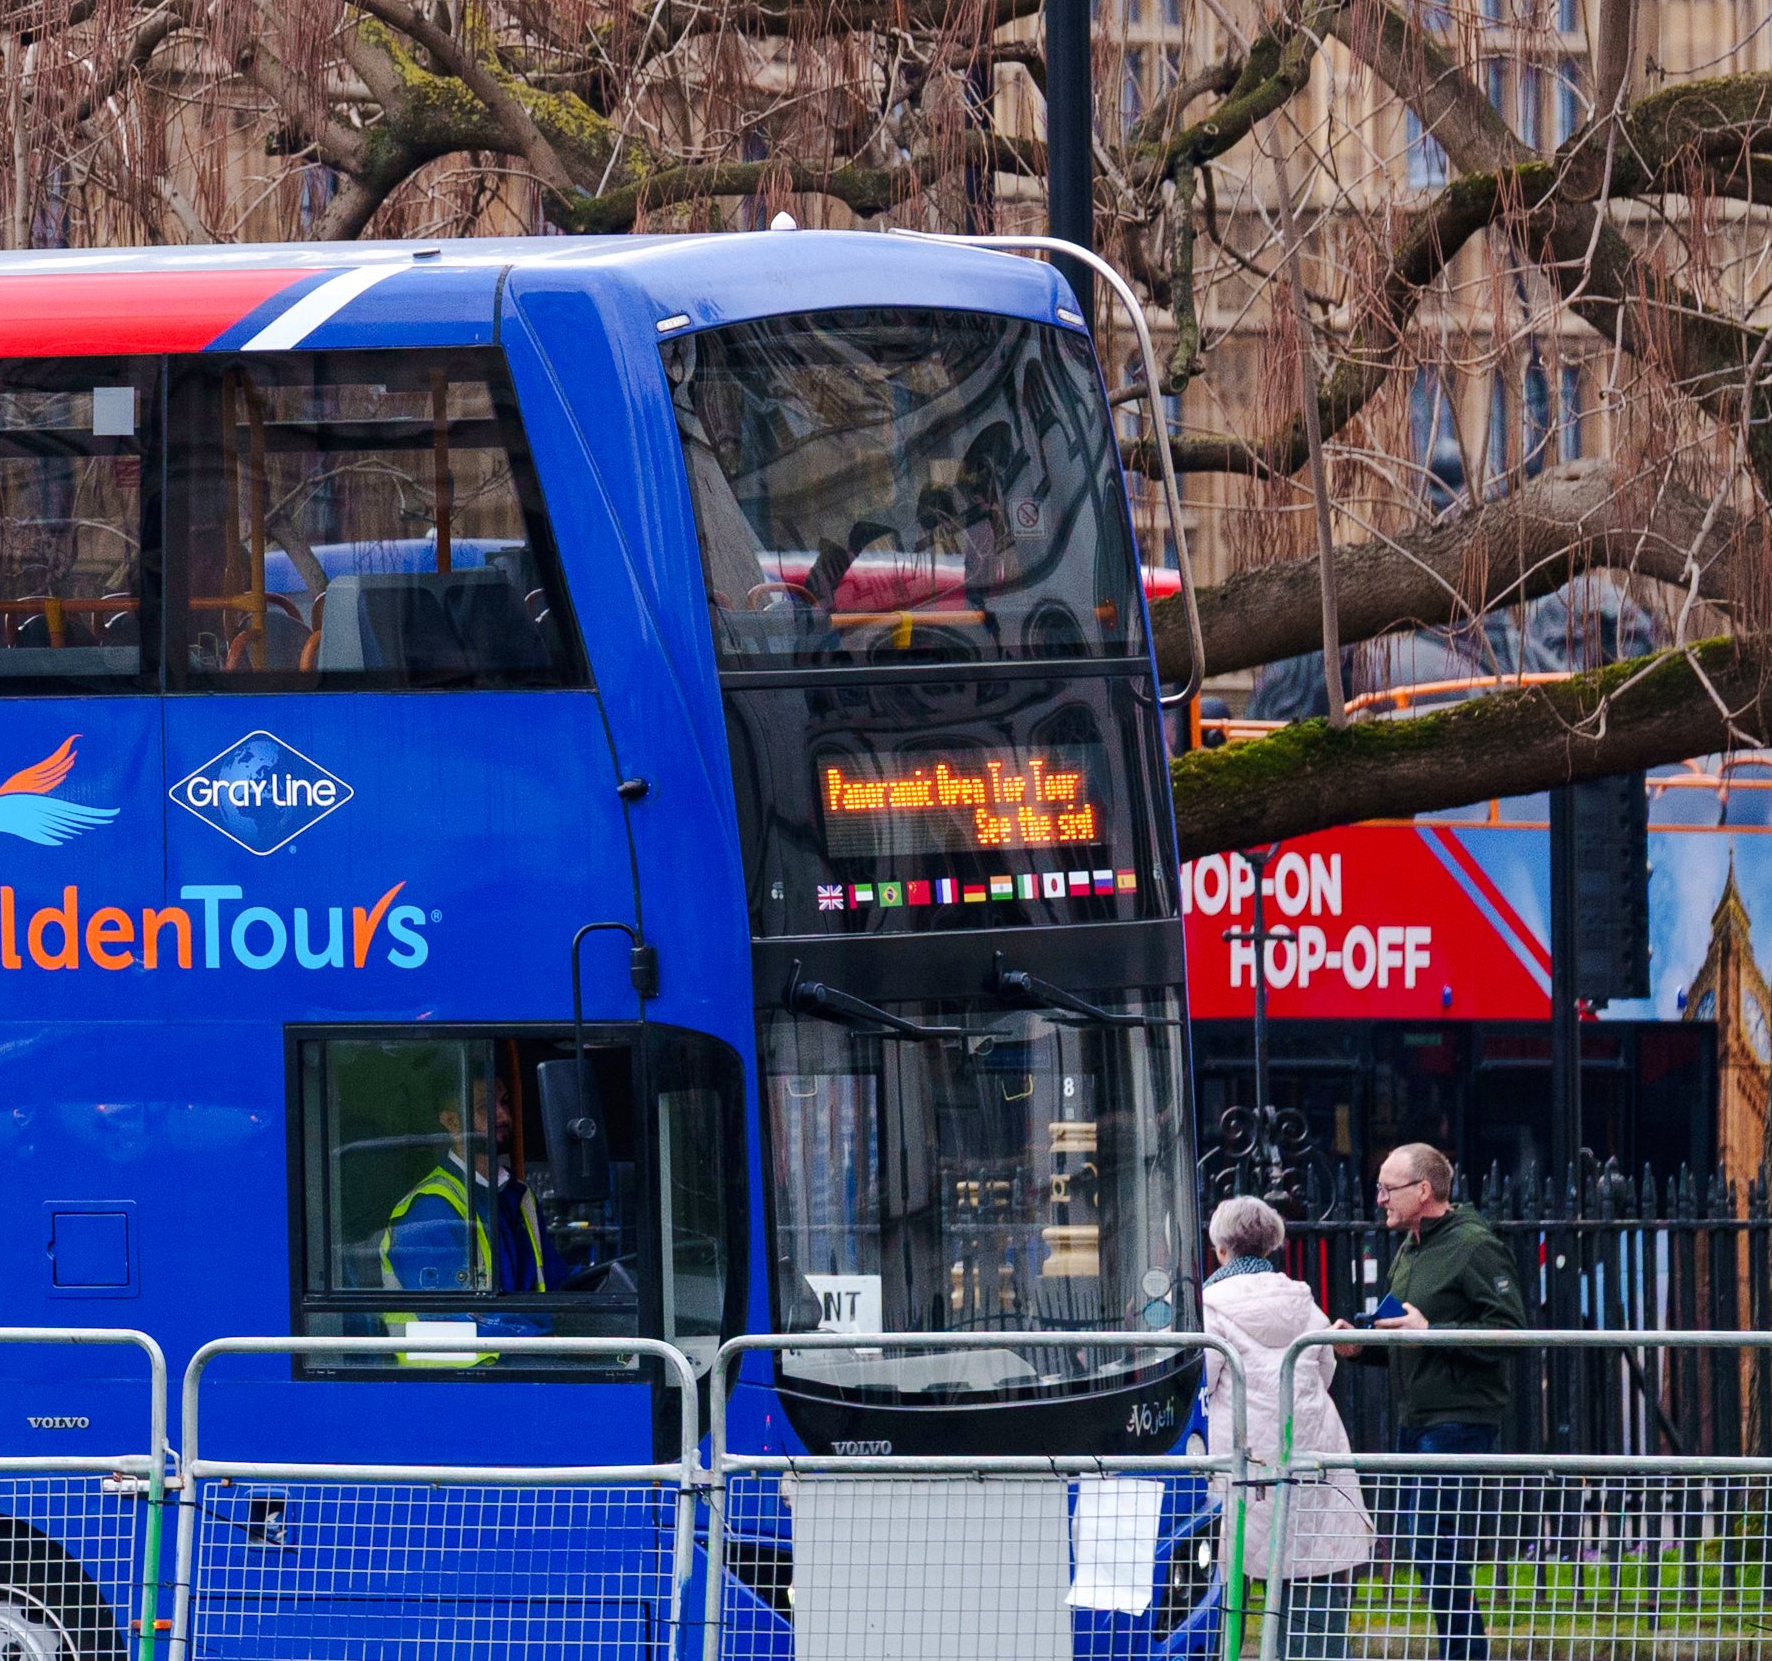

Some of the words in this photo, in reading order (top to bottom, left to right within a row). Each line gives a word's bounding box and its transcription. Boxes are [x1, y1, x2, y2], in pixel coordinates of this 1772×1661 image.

[826, 768, 934, 810] Panoramic
[936, 763, 985, 805] Open
[987, 761, 1025, 803] Top
[1028, 760, 1079, 801] Tour
[975, 808, 1011, 844] See
[1017, 805, 1051, 842] the
[1230, 923, 1432, 990] HOP-OFF
[1063, 1077, 1075, 1098] 8
[27, 1416, 90, 1429] VOLVO
[831, 1440, 892, 1456] VOLVO
